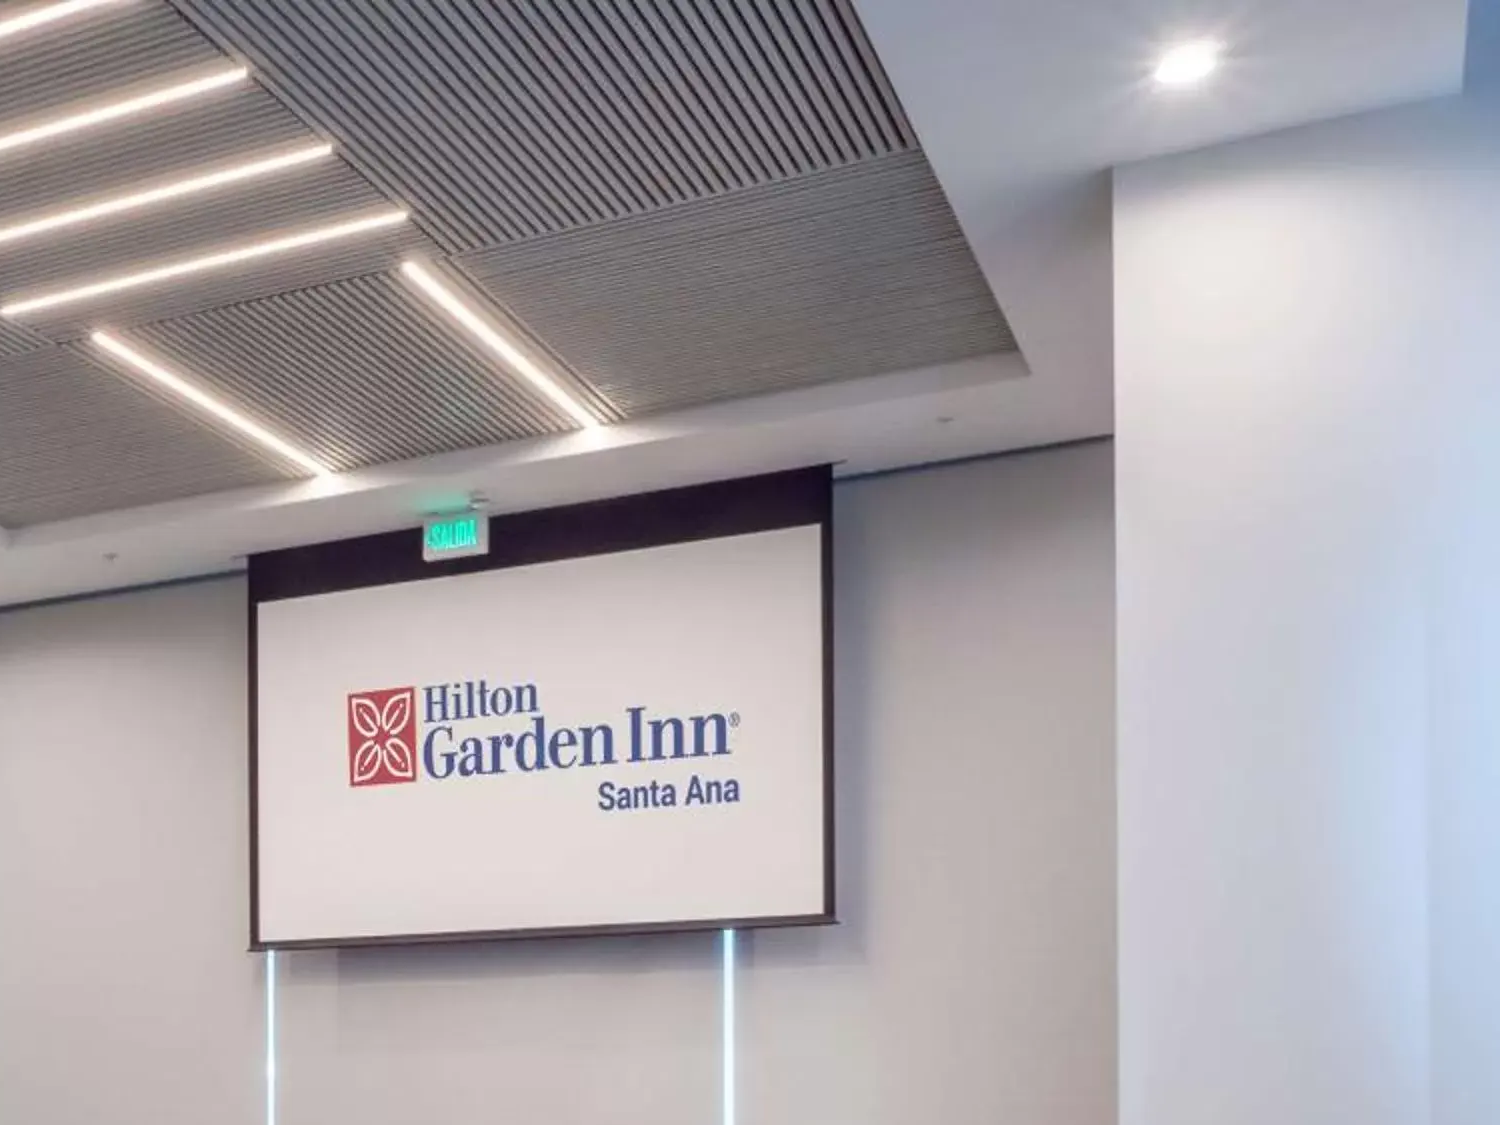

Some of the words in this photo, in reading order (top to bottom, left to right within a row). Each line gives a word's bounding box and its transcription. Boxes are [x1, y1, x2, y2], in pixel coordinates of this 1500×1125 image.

[422, 679, 539, 723] Hilton
[423, 715, 618, 779] Garden
[598, 779, 676, 811] Santa
[685, 775, 740, 805] Ana
